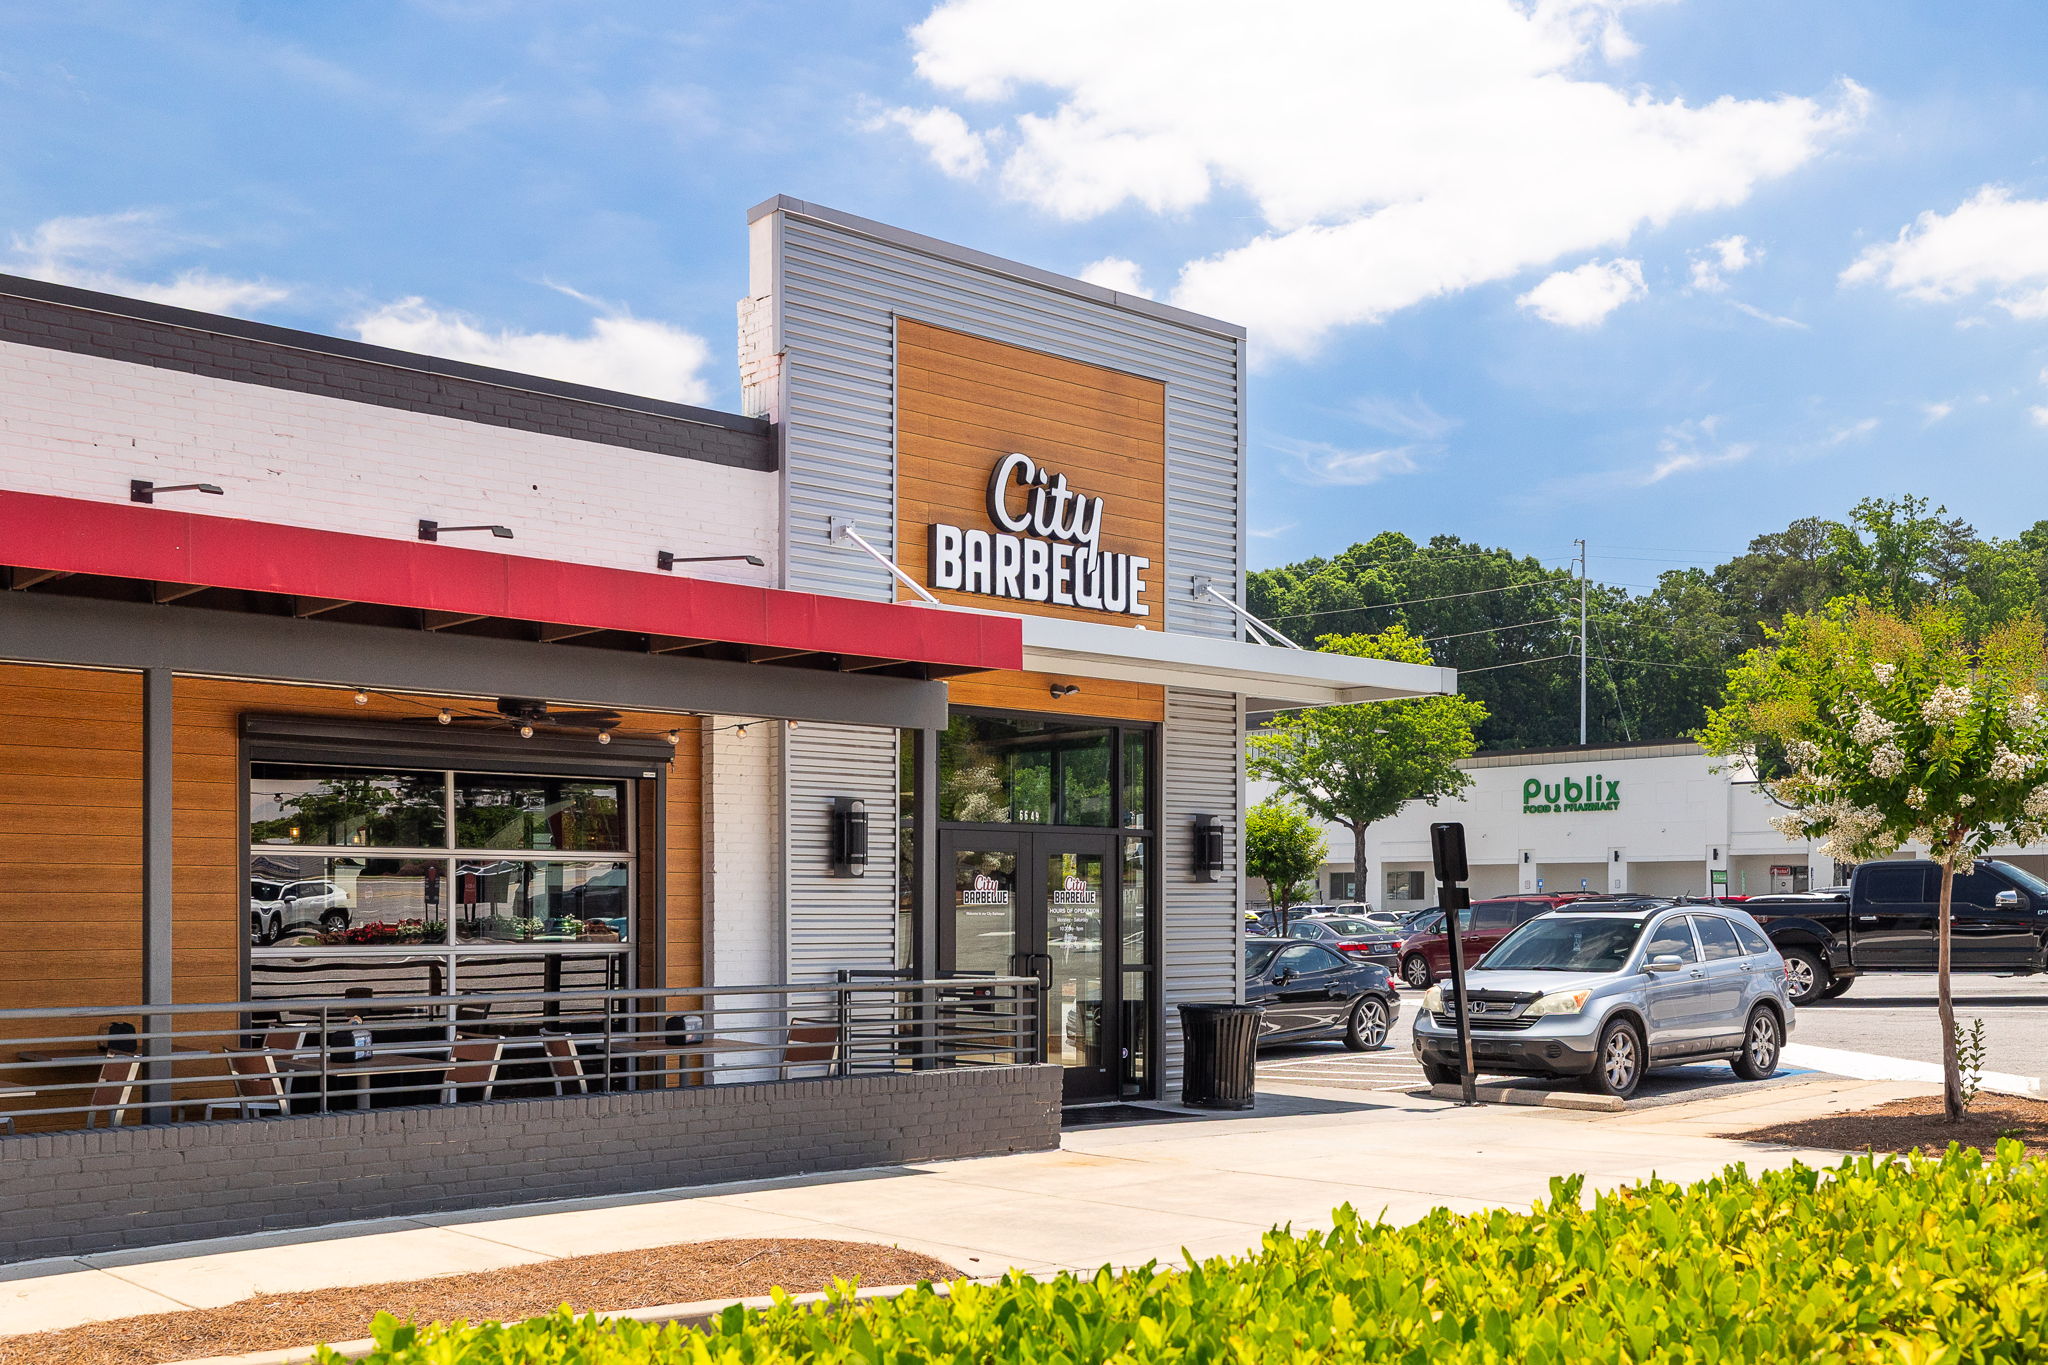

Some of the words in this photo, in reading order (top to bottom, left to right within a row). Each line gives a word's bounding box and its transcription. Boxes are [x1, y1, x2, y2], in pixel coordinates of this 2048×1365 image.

[987, 452, 1104, 575] City
[928, 523, 1149, 616] BARBEQUE
[1523, 774, 1620, 805] Publix
[1019, 809, 1040, 822] 6649
[1523, 804, 1551, 814] FOOD
[1553, 803, 1562, 813] &
[1563, 801, 1620, 812] PHARMACY
[975, 874, 998, 897] City
[1065, 875, 1087, 897] City
[963, 890, 1008, 904] BARBEQUE
[1054, 891, 1096, 904] BARBEQUE
